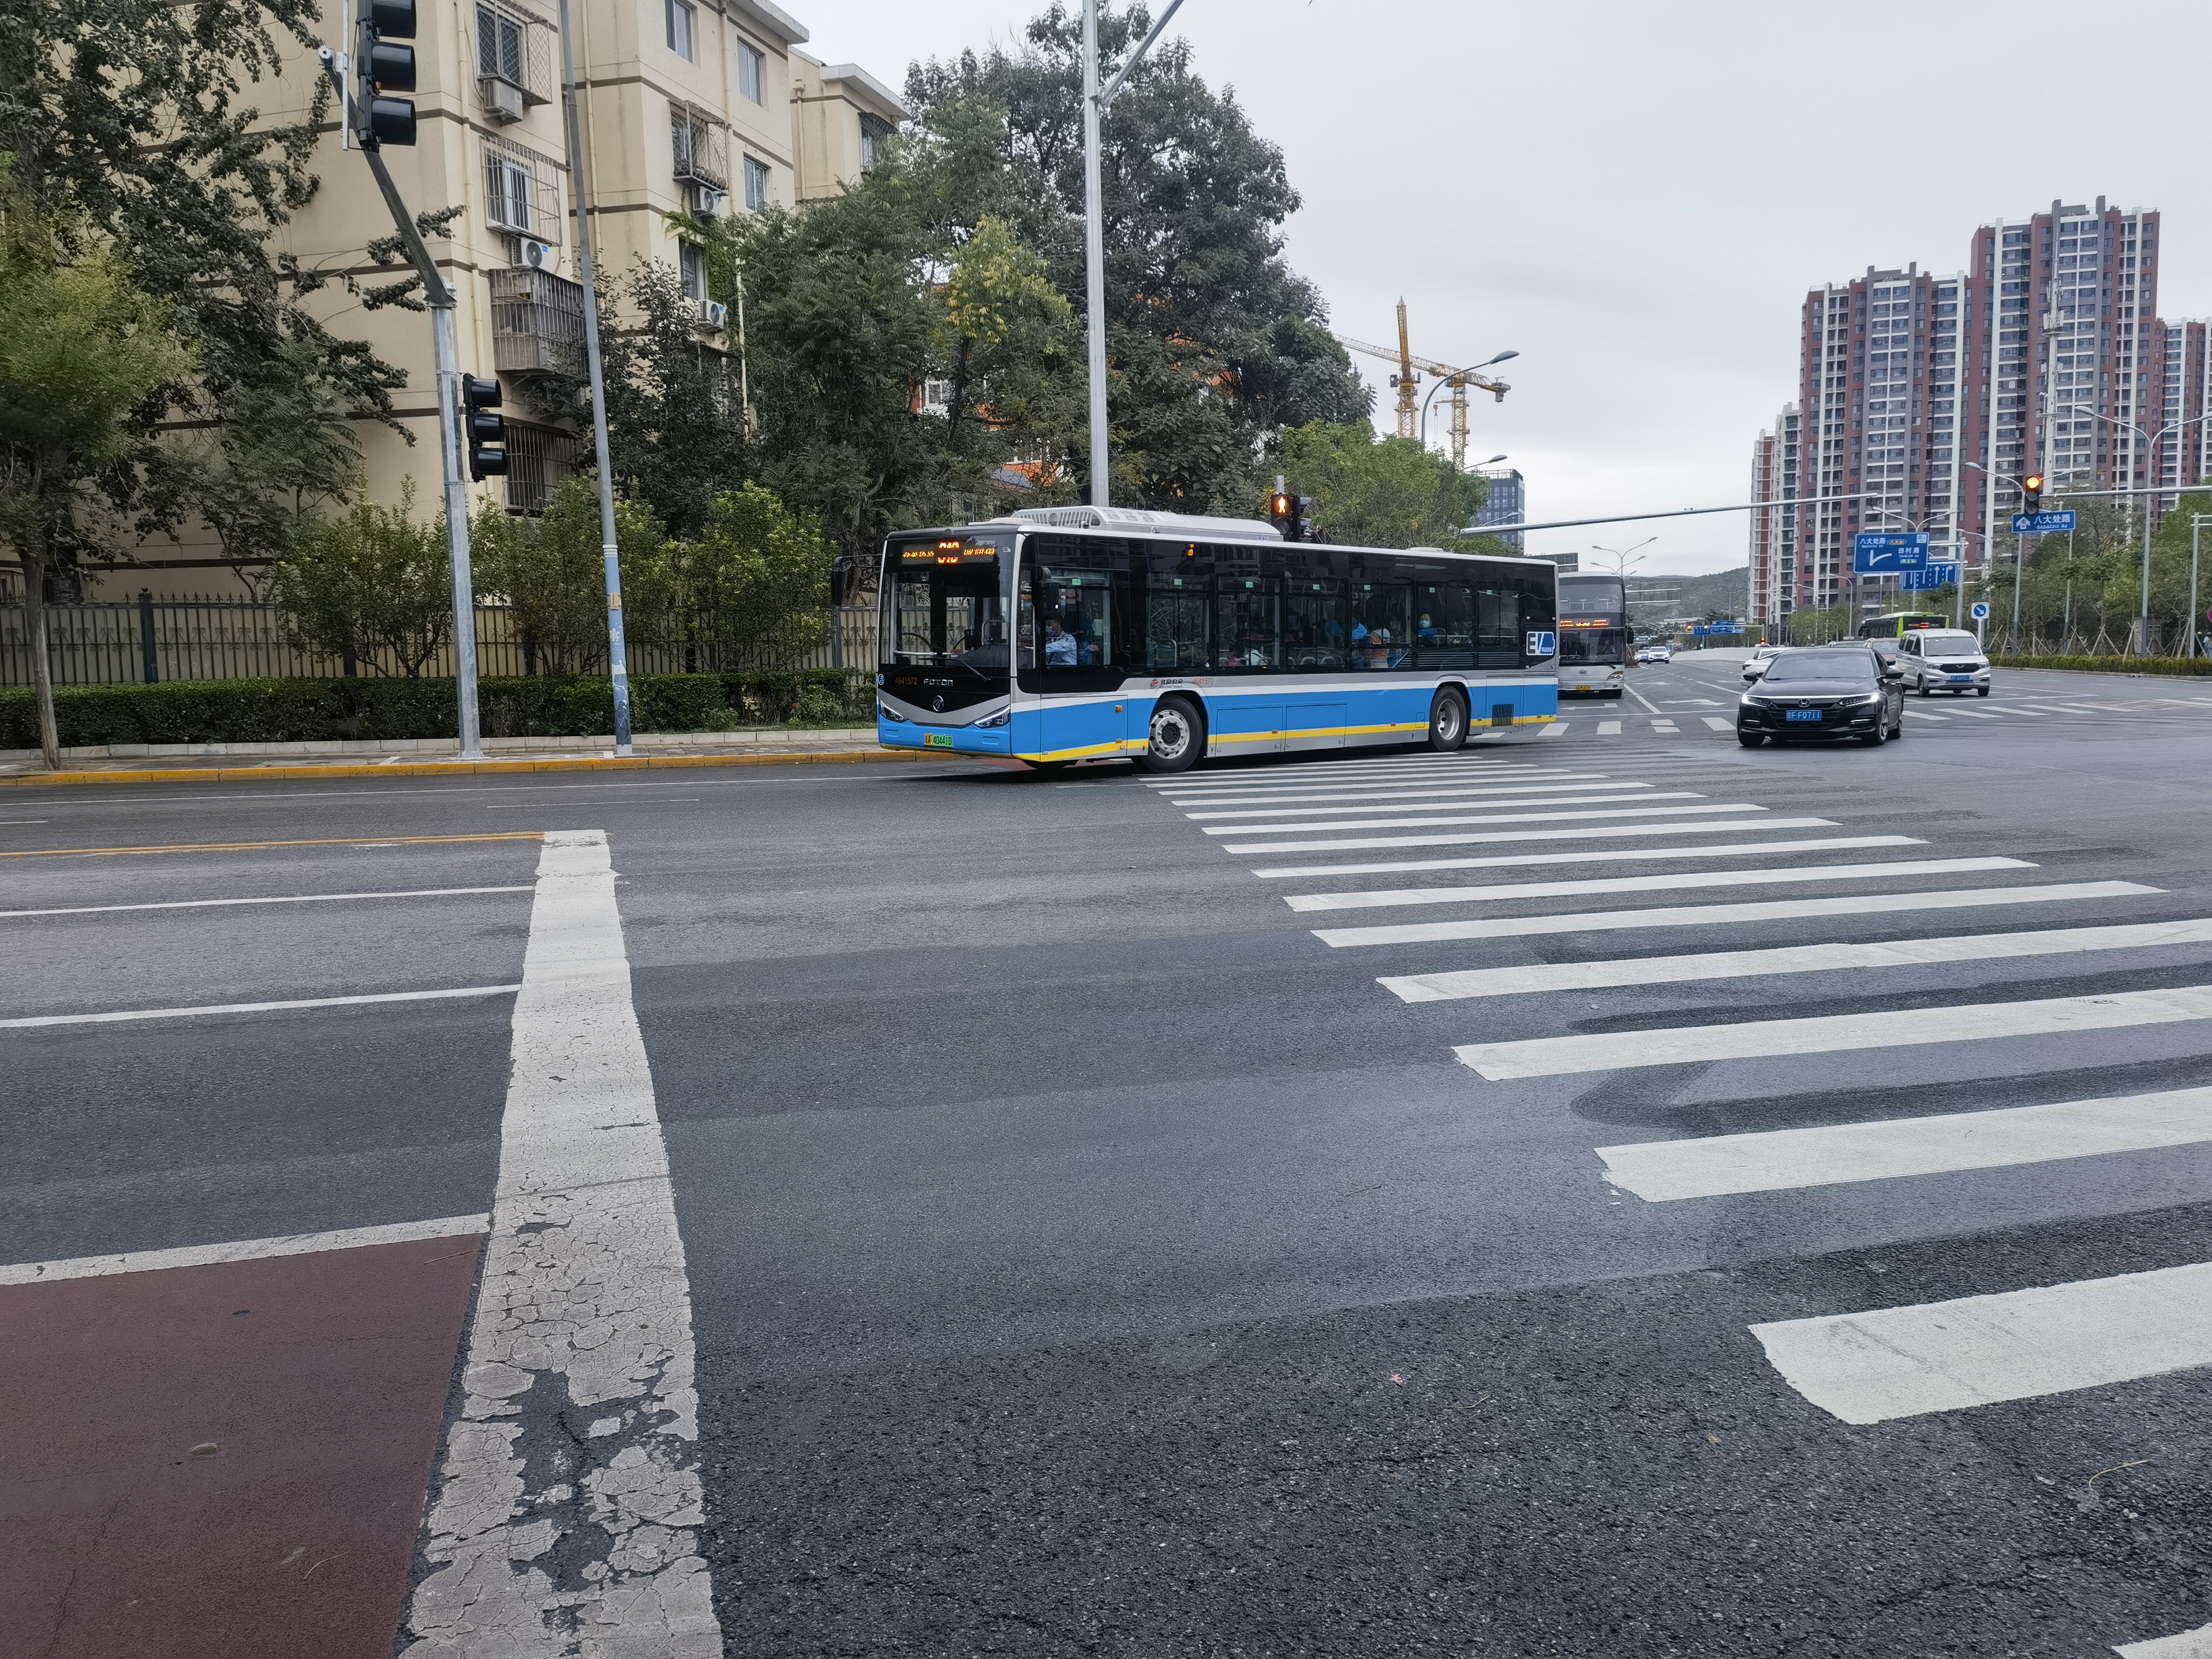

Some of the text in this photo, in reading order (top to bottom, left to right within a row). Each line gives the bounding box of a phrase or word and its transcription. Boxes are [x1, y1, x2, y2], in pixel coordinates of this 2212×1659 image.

[2034, 514, 2071, 524] 八大处路
[895, 677, 953, 686] 4641572 FOTON
